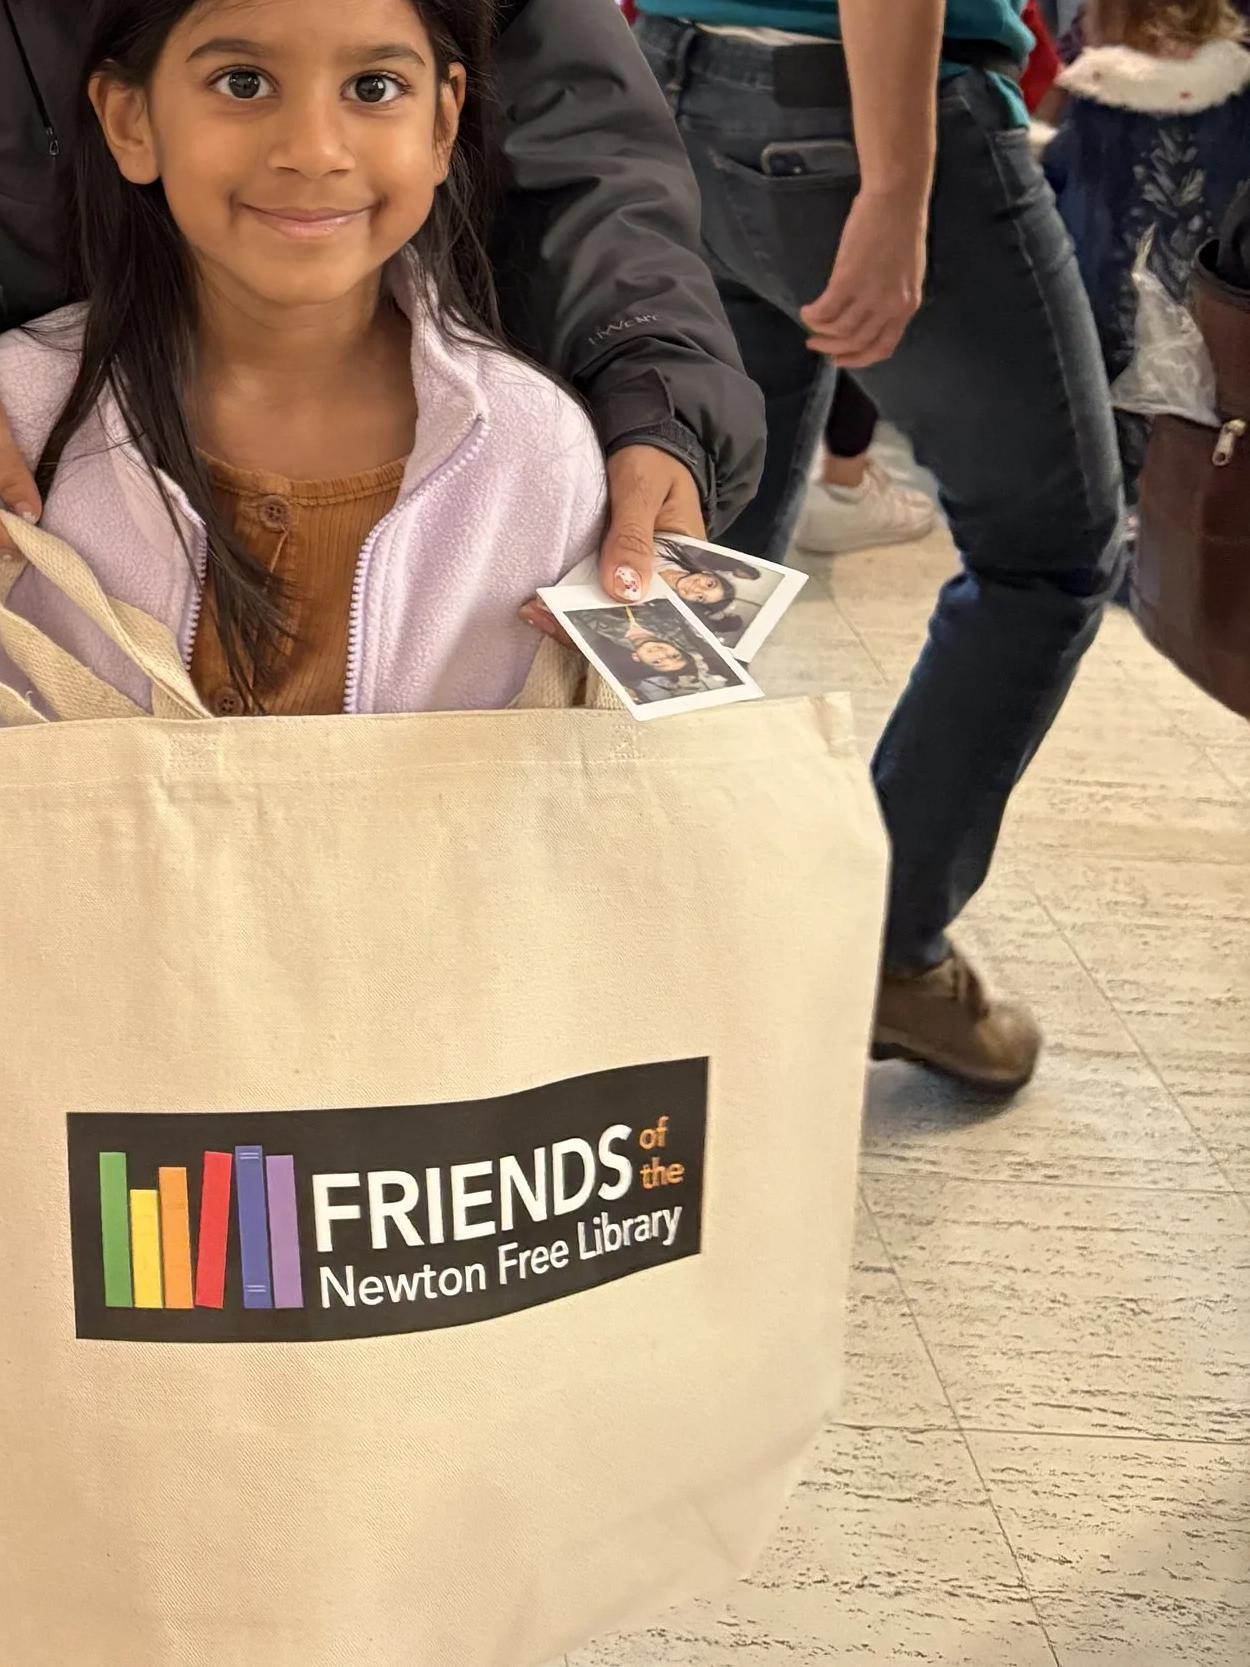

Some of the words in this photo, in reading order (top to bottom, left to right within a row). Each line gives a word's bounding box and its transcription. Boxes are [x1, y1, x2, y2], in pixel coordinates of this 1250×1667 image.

[638, 1115, 670, 1149] of
[311, 1125, 633, 1253] FRIENDS
[639, 1154, 685, 1191] the
[319, 1264, 487, 1308] Newton
[497, 1241, 570, 1285] Free
[577, 1206, 684, 1261] Library
